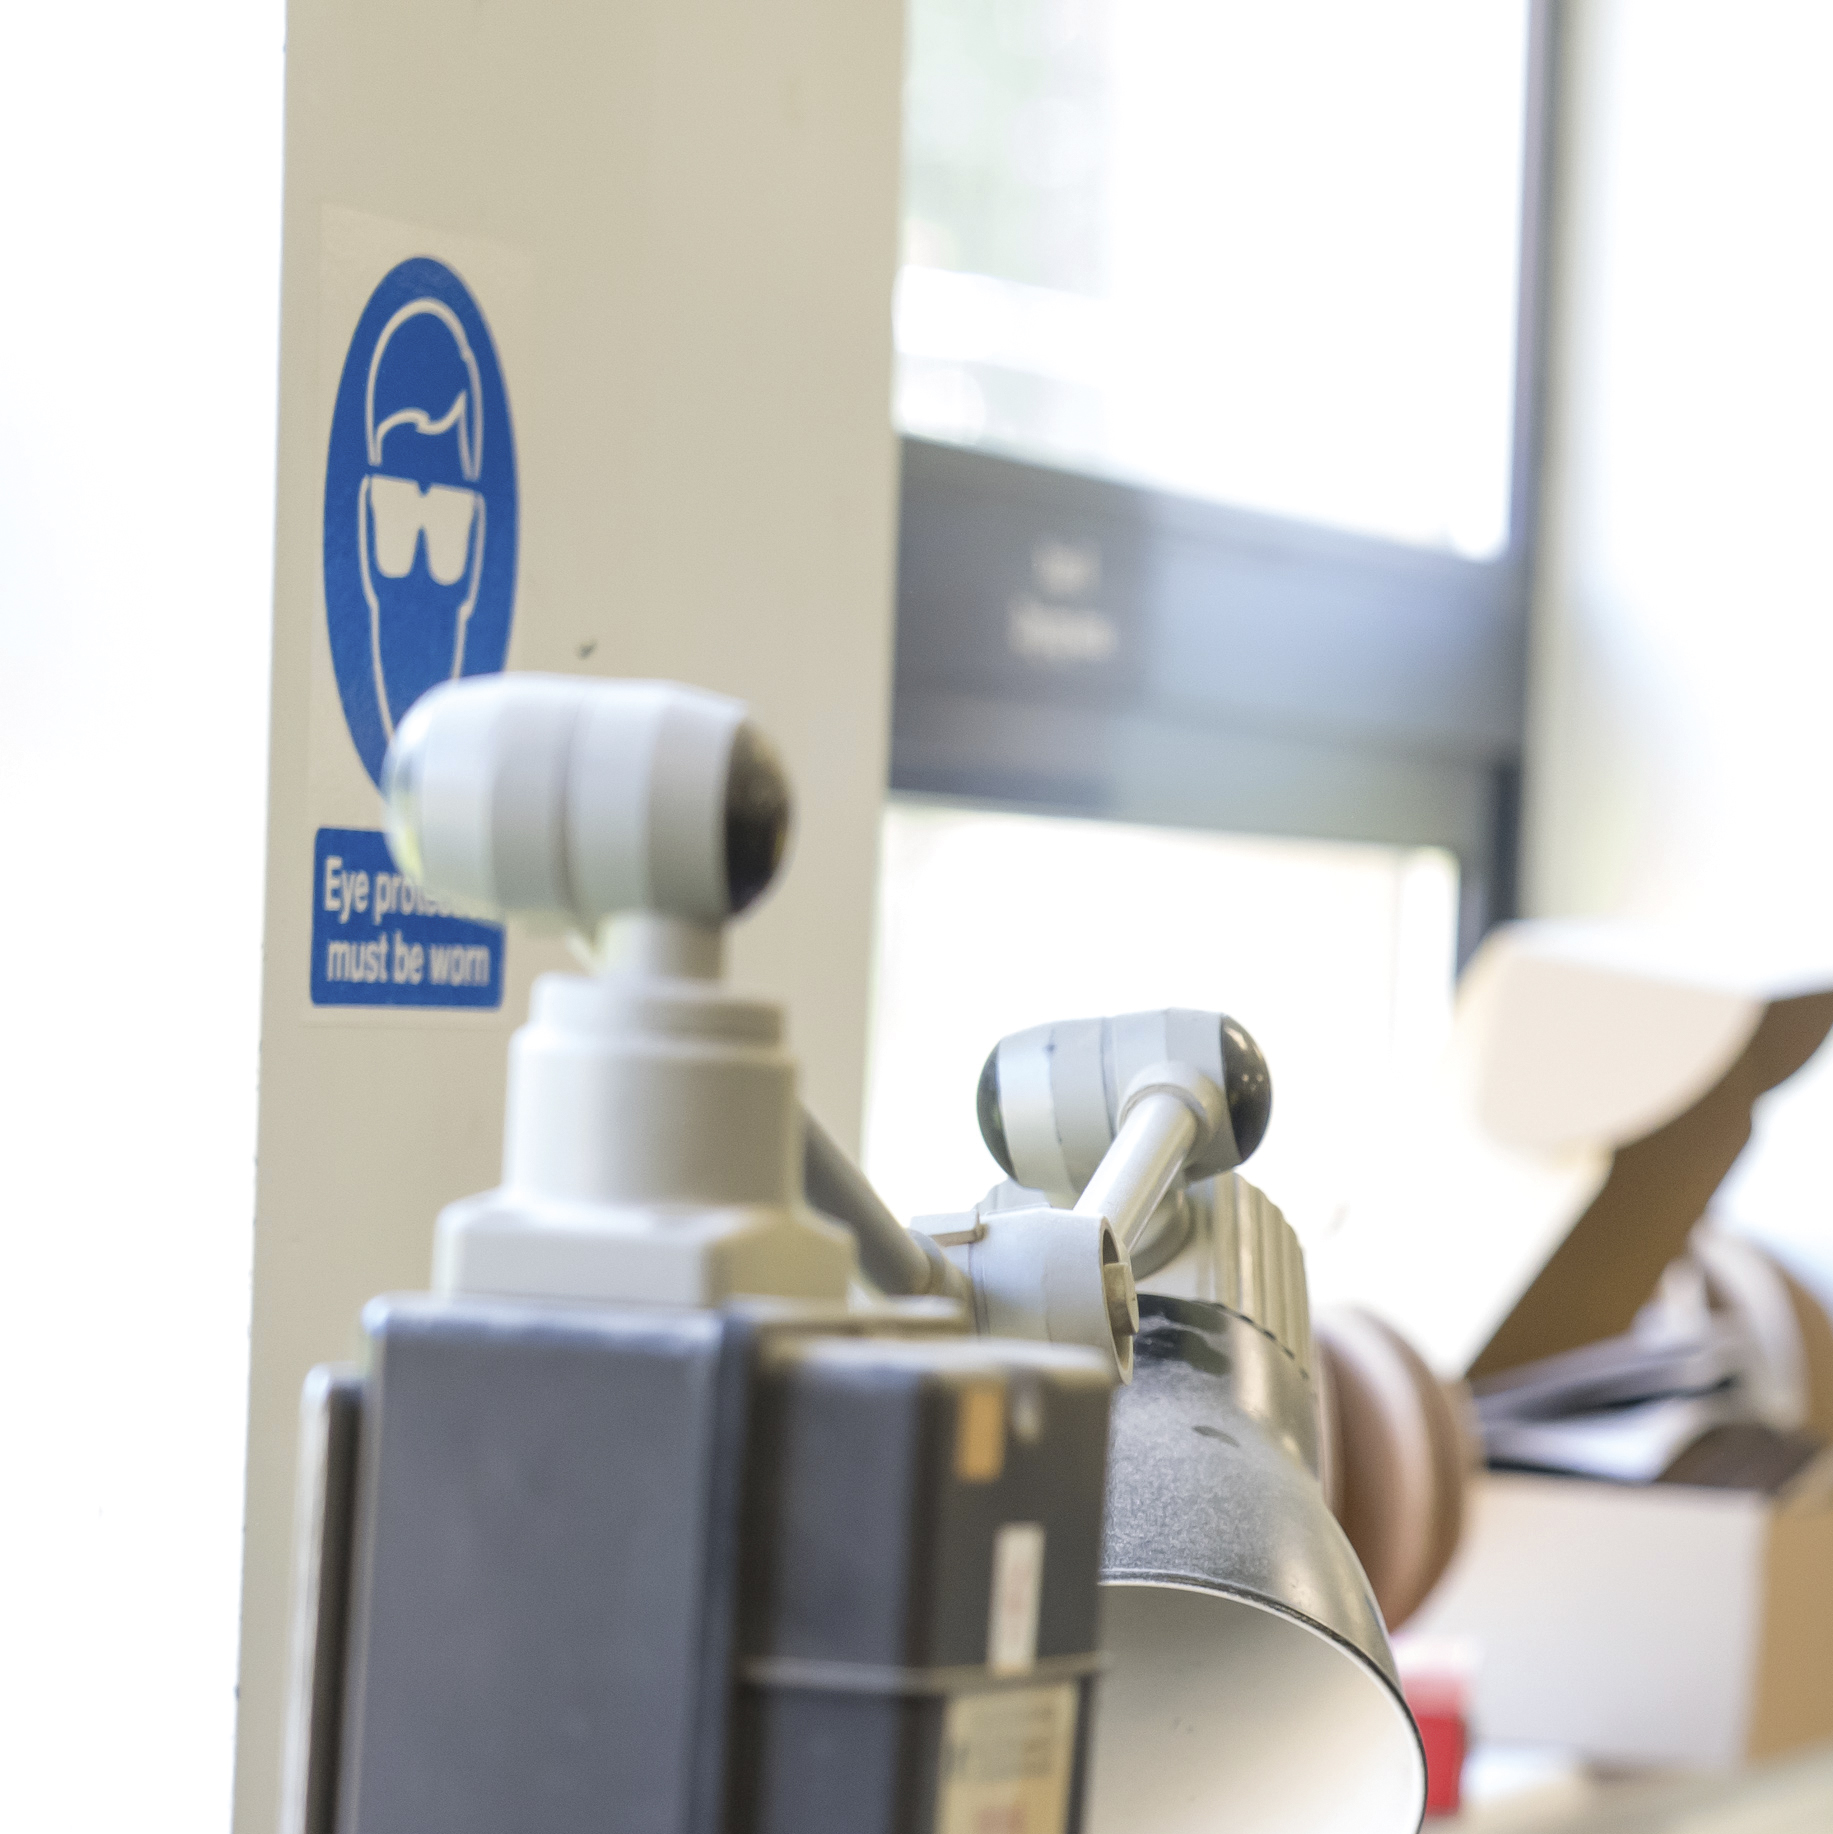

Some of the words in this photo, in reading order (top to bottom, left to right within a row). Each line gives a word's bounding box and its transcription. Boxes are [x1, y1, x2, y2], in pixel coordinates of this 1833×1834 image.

[324, 856, 370, 925] Eye
[326, 931, 388, 984] must
[392, 930, 424, 985] be
[430, 945, 490, 987] worn
